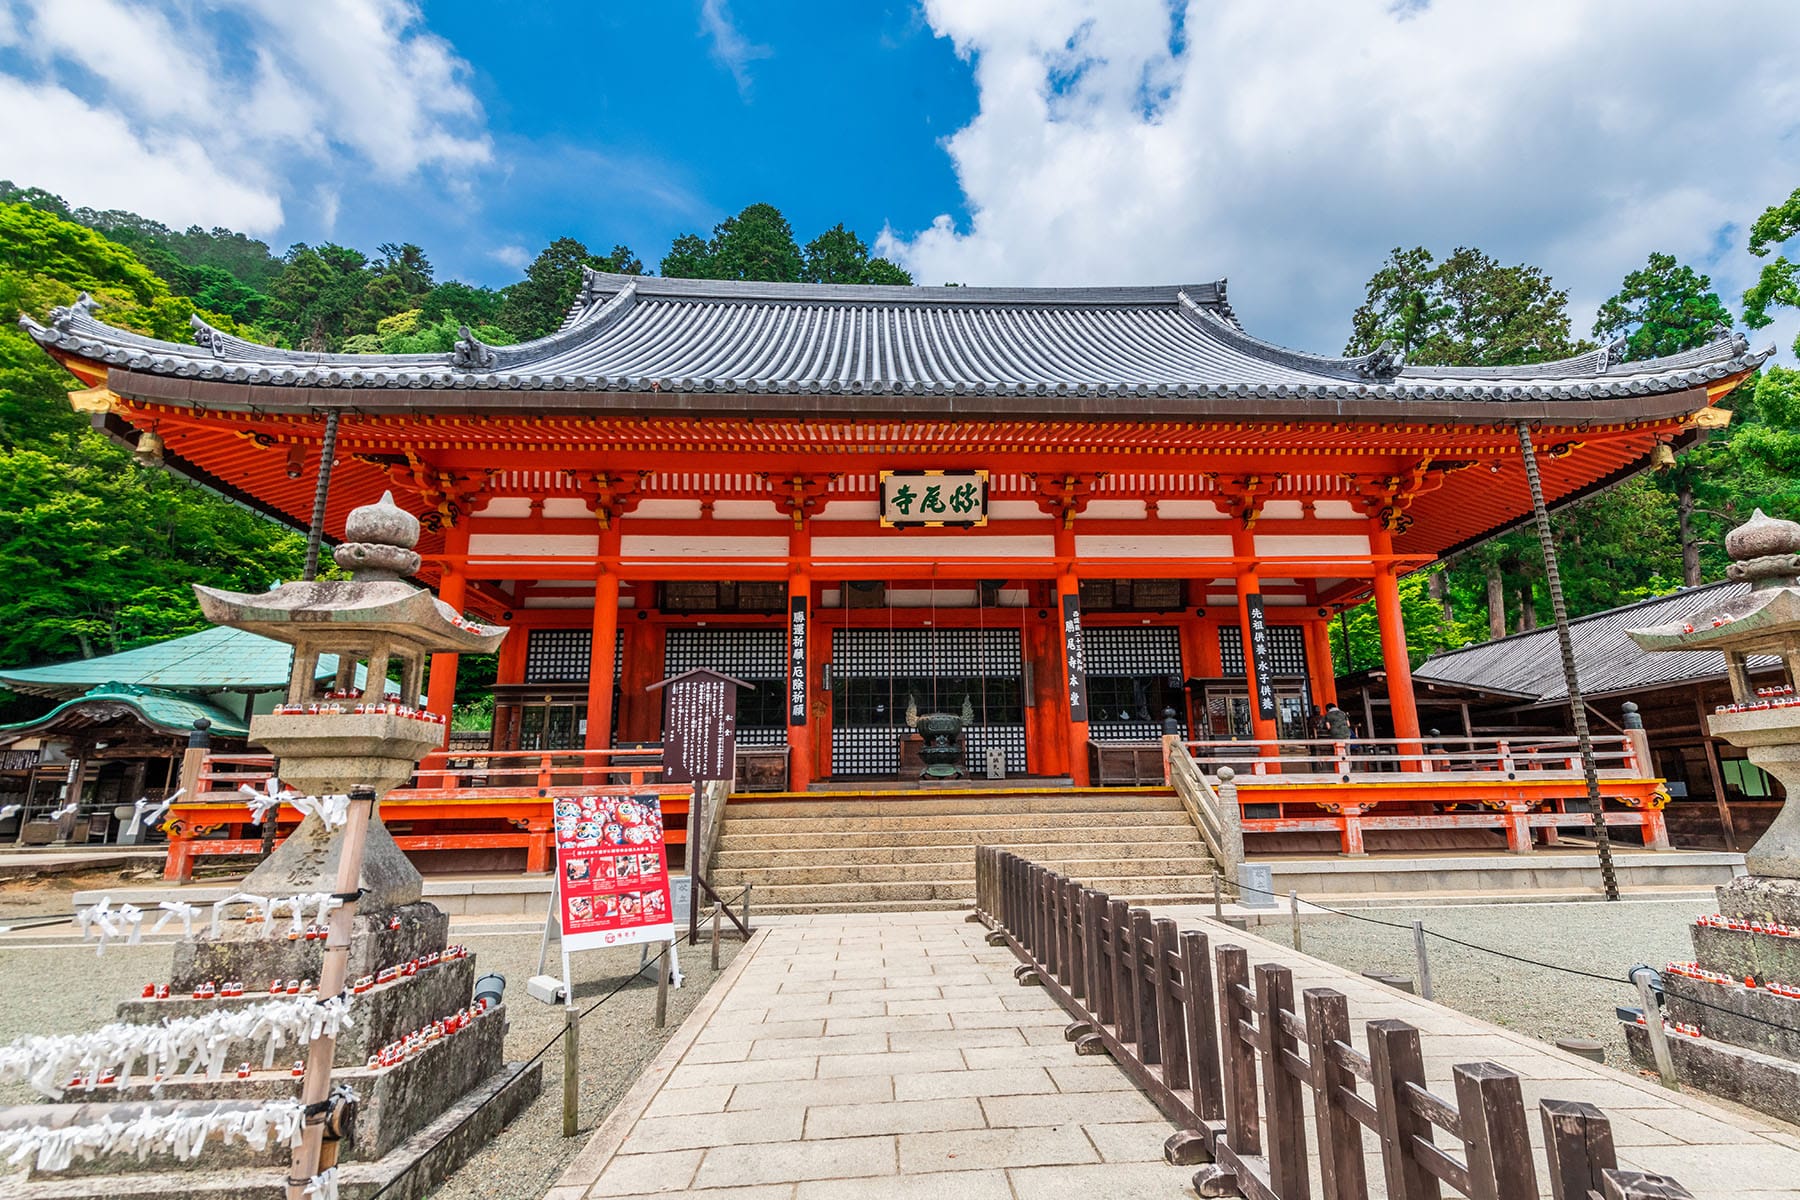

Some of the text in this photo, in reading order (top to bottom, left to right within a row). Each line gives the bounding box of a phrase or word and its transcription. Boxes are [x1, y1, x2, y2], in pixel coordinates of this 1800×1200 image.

[791, 611, 806, 717] 勝運祈願・厄除祈願
[1251, 607, 1274, 710] 先祖供養・水子供養
